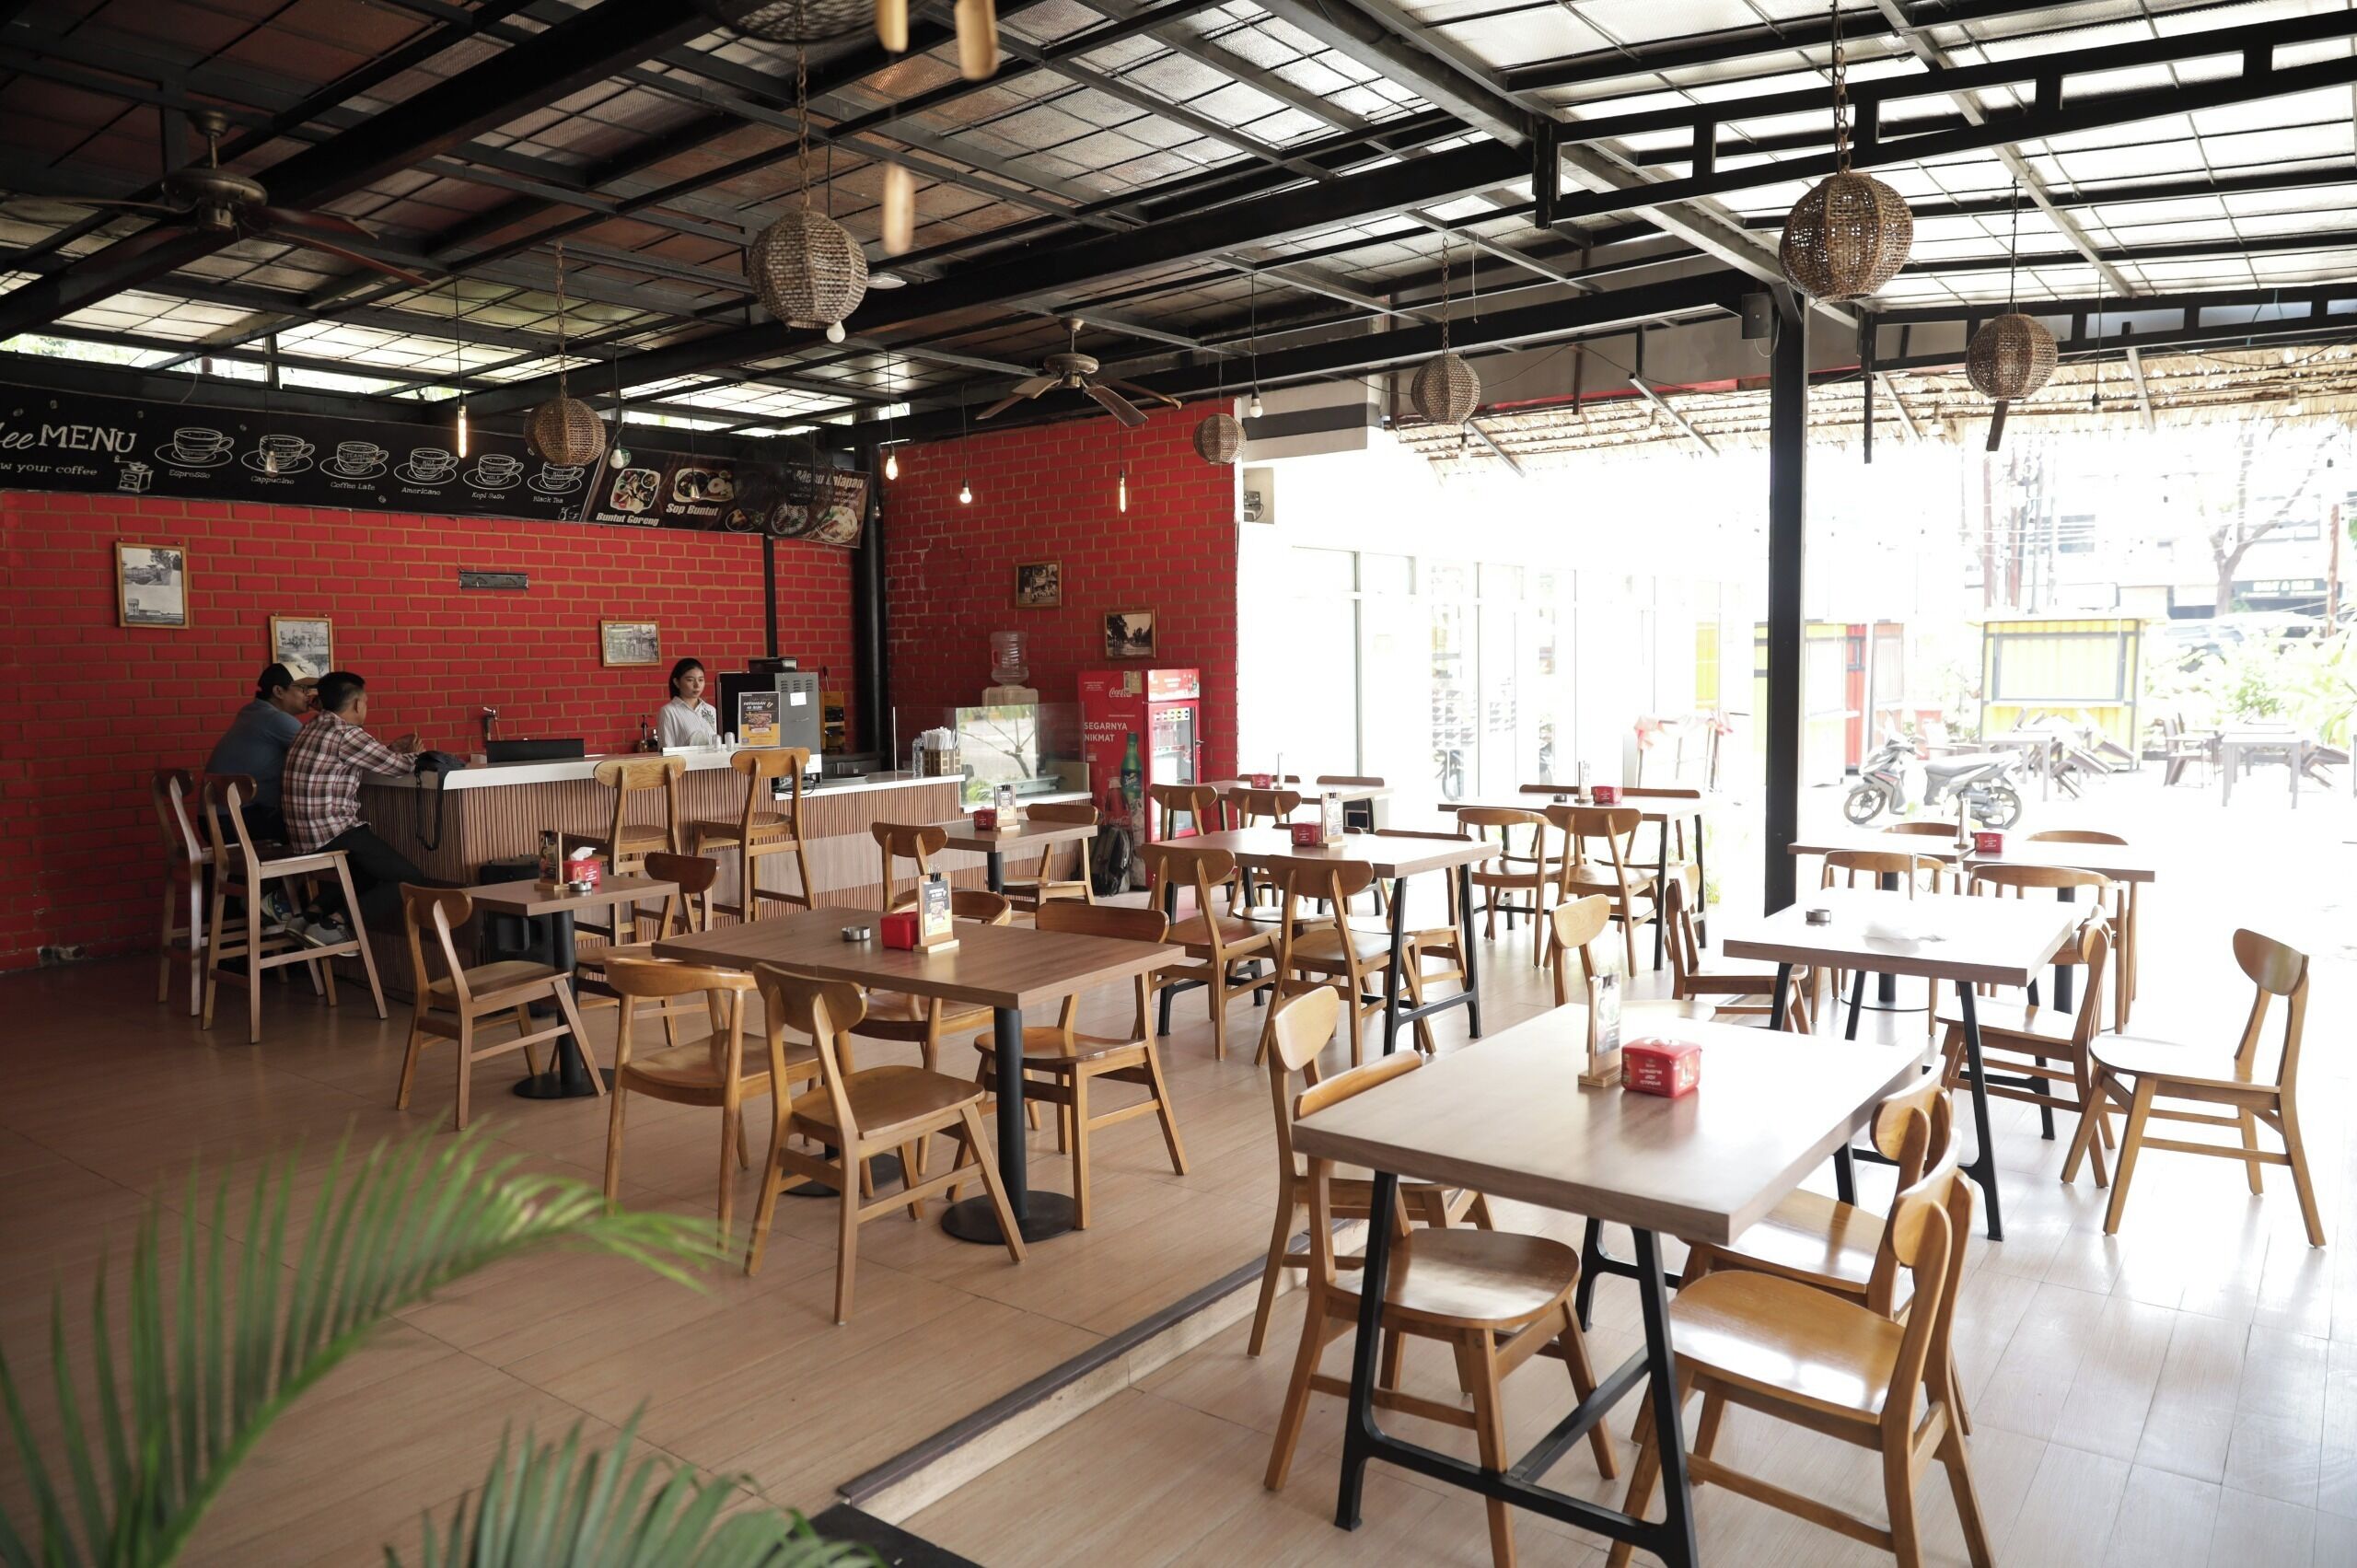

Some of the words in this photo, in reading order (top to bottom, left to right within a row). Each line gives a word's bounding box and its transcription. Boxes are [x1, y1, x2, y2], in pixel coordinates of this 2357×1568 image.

[38, 424, 137, 453] MENU
[17, 464, 52, 473] your
[55, 465, 98, 476] coffee
[330, 481, 356, 490] Coffee
[401, 487, 441, 495] Americano
[471, 492, 486, 500] Kopi
[666, 503, 685, 515] Sop
[687, 505, 719, 516] Buntut
[596, 512, 626, 523] Buntut
[627, 515, 660, 527] Goreng
[1084, 722, 1128, 730] SEGARNYA
[1084, 734, 1115, 742] NIKMAT
